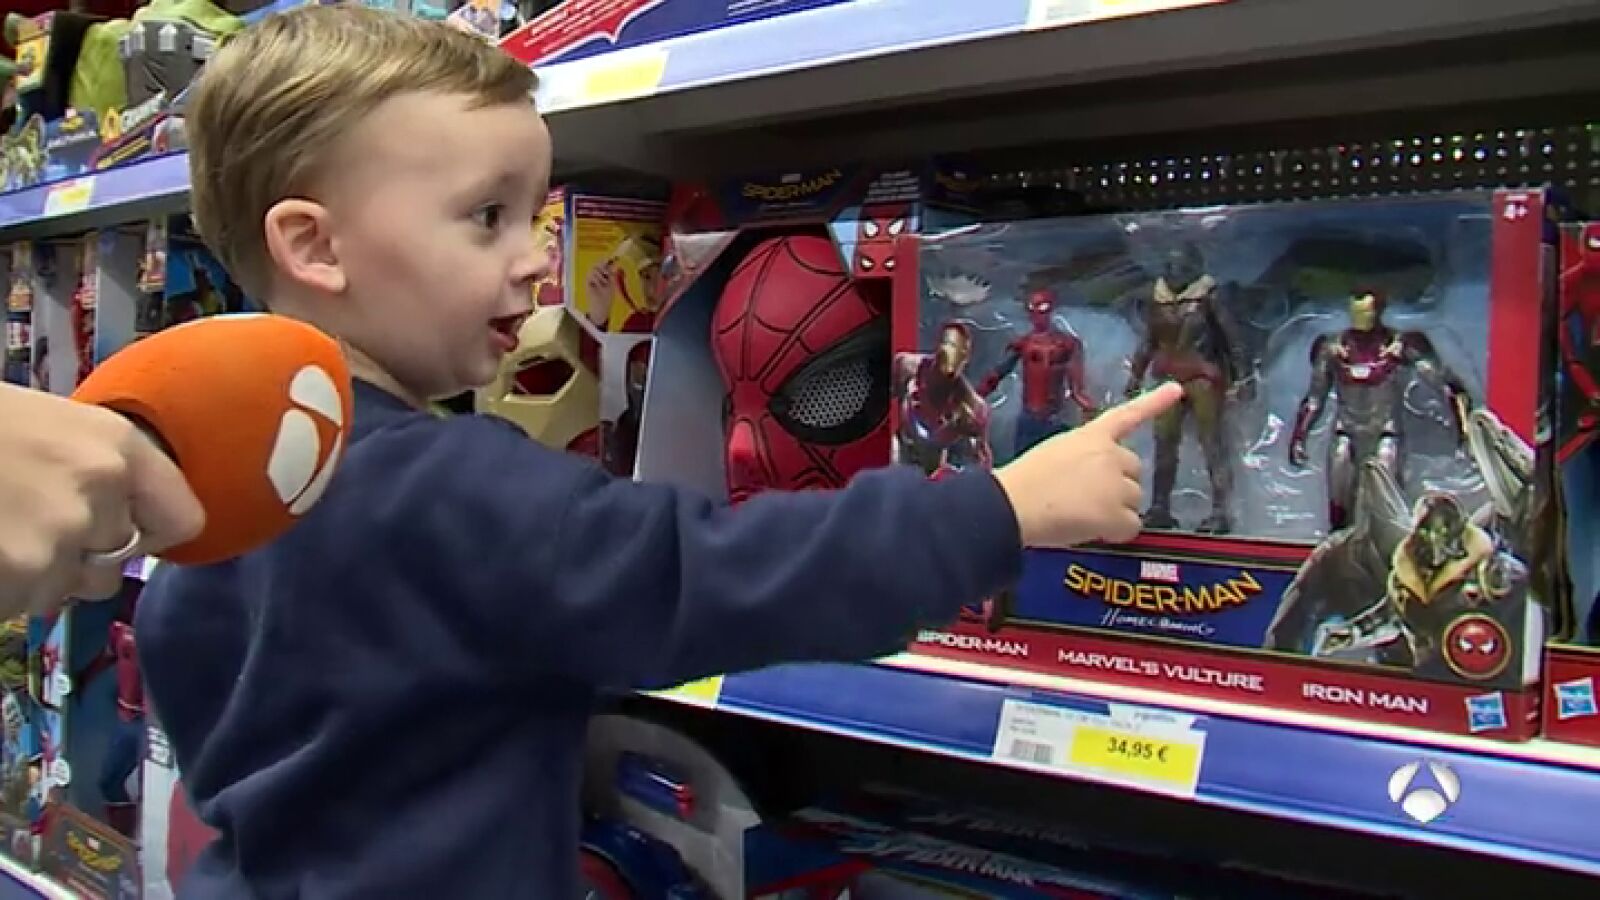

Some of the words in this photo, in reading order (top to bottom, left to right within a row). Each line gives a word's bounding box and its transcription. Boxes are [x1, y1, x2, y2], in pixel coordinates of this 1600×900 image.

[1064, 562, 1263, 613] SPIDER-MAN
[917, 629, 1029, 656] SPIDER-MAN
[1057, 648, 1160, 676] MARVEL'S
[1163, 663, 1265, 692] VULTURE
[1302, 682, 1364, 705] IRON
[1368, 690, 1427, 714] MAN
[1106, 735, 1153, 760] 34,95
